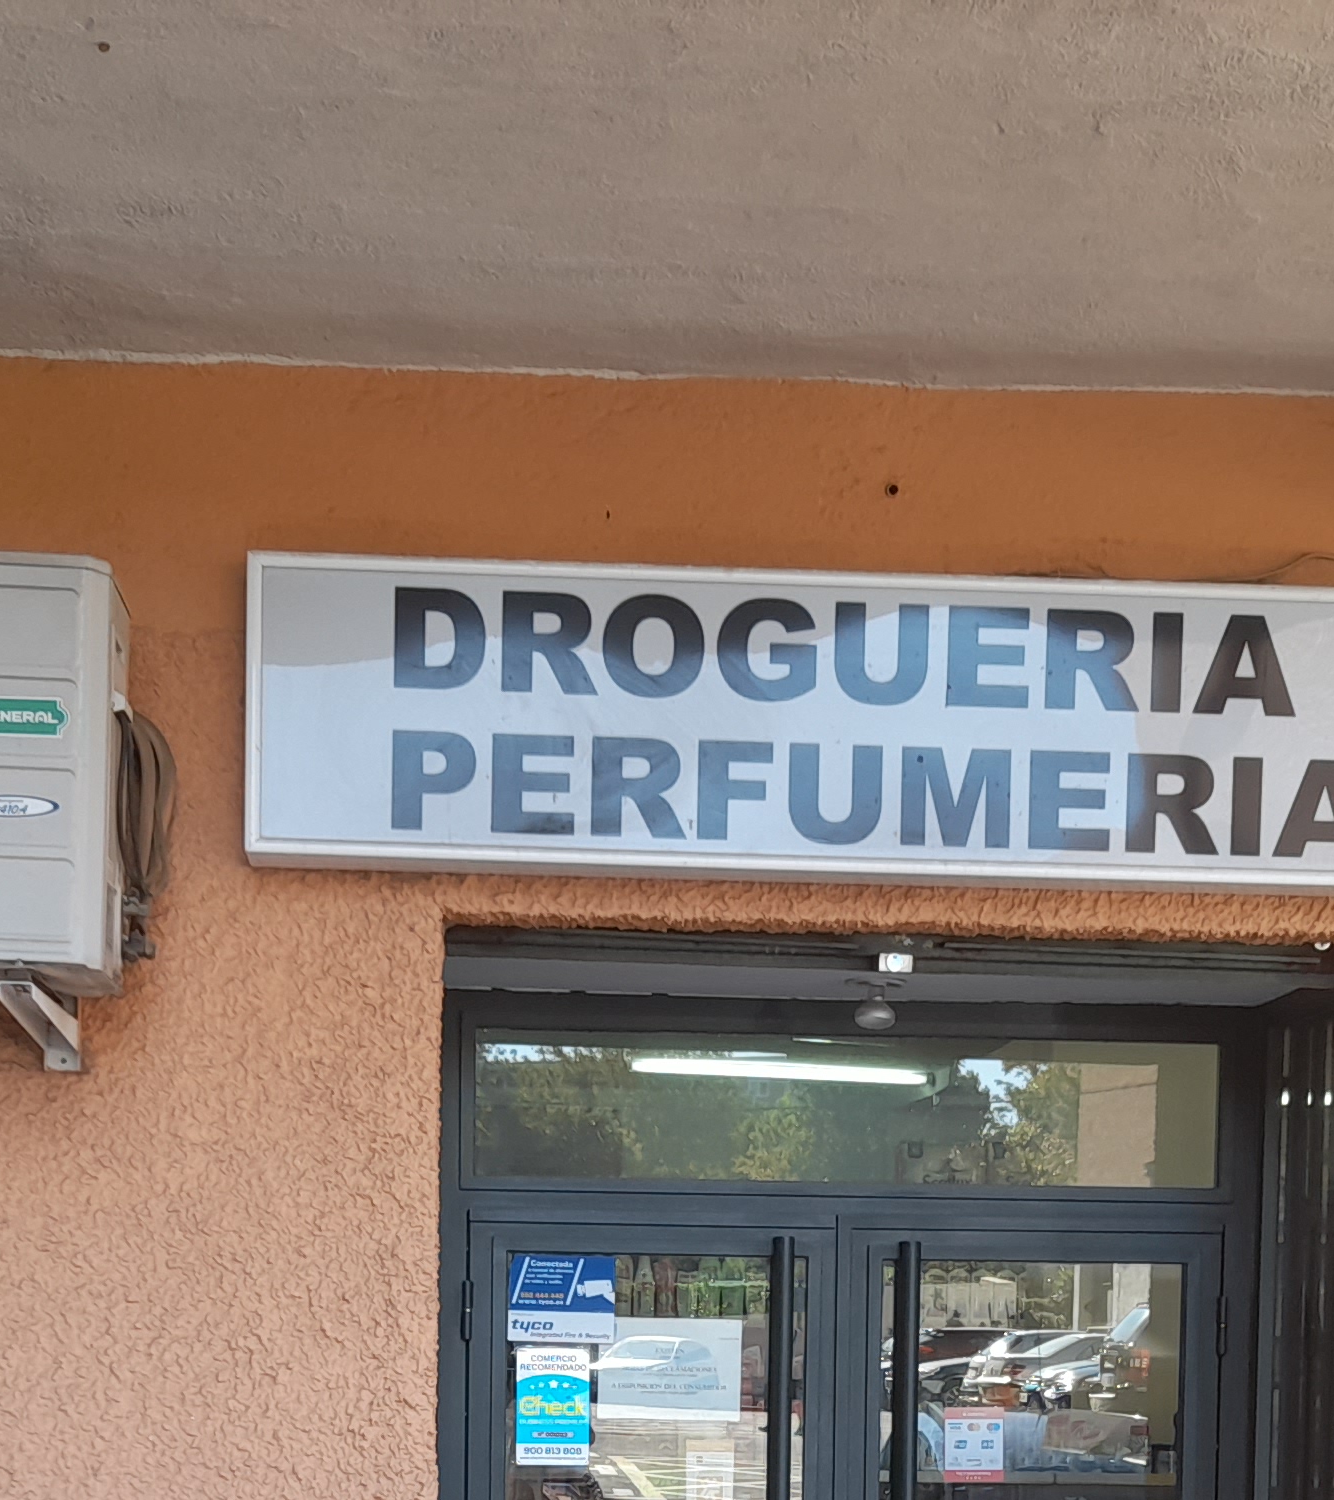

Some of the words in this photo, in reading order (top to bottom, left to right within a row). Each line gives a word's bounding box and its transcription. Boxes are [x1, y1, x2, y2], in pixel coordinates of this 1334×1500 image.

[392, 585, 1295, 717] DROGUERIA
[511, 1319, 554, 1333] tyco
[520, 1363, 587, 1371] RECOMENDADO
[519, 1396, 586, 1417] Check
